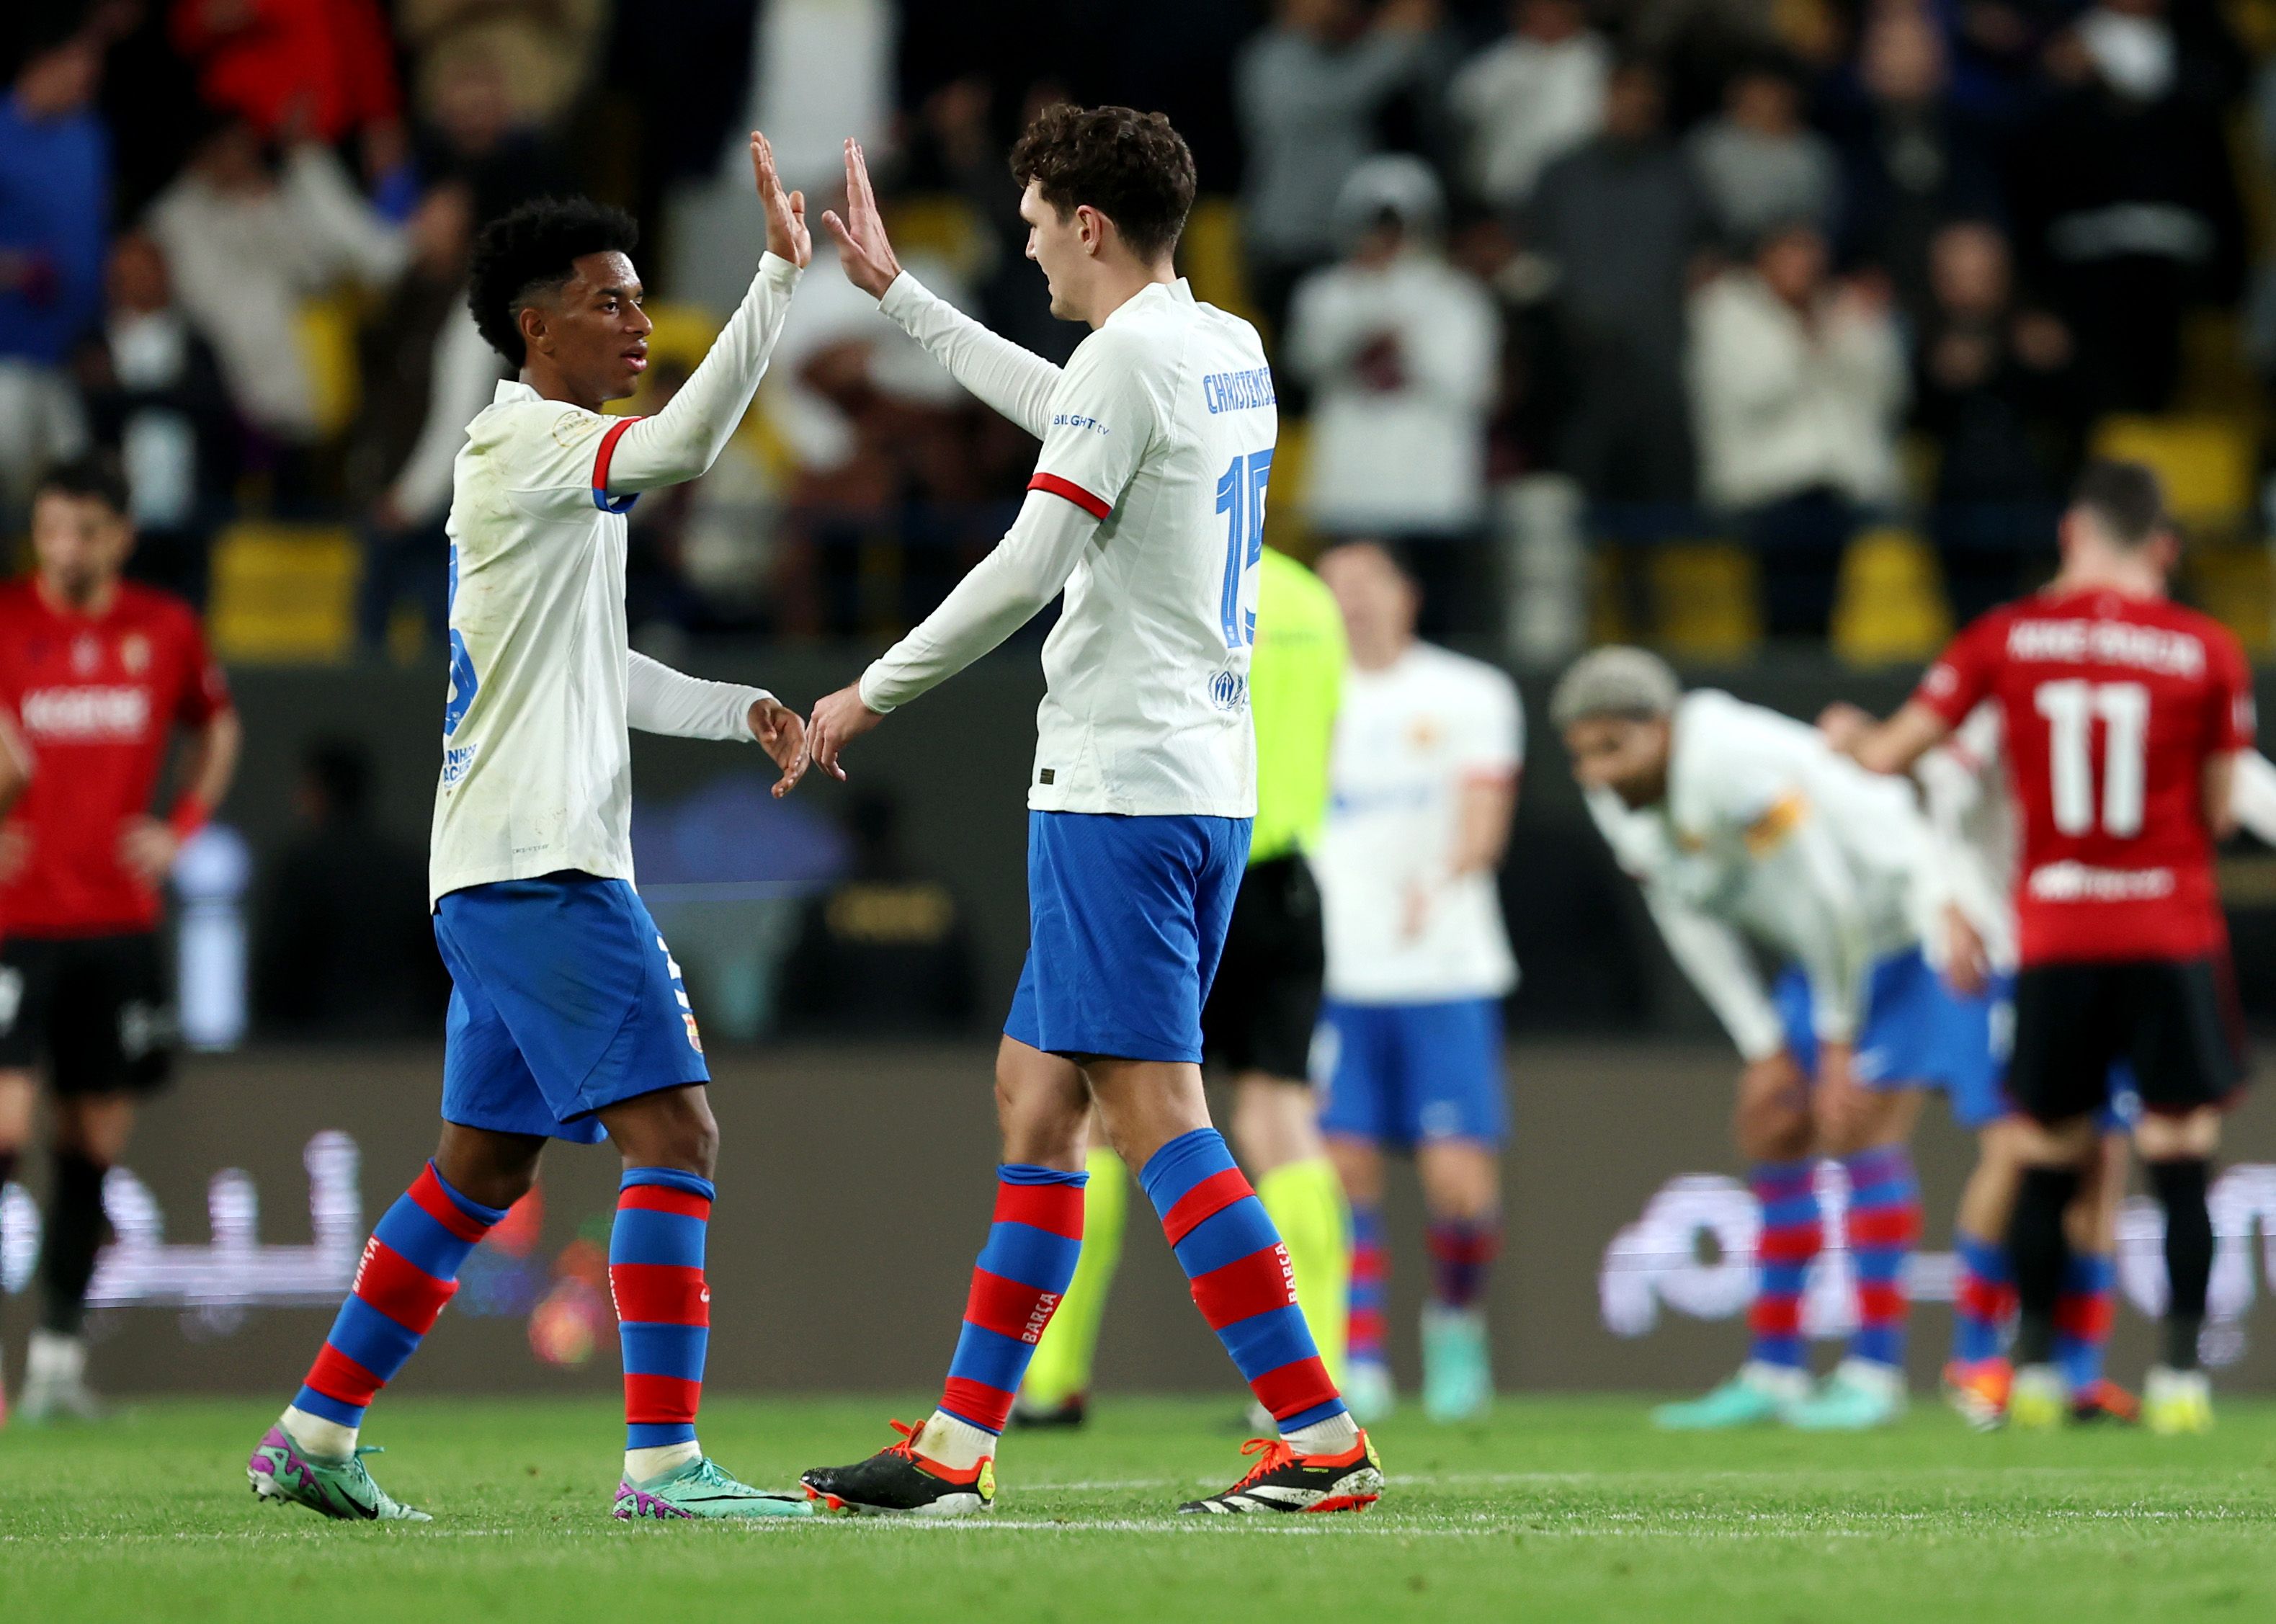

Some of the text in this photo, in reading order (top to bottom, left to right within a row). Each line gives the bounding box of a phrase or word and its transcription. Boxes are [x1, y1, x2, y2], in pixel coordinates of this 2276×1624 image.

[1097, 424, 1110, 434] tv
[2033, 677, 2151, 840] 11
[1021, 1293, 1058, 1344] BARÇA
